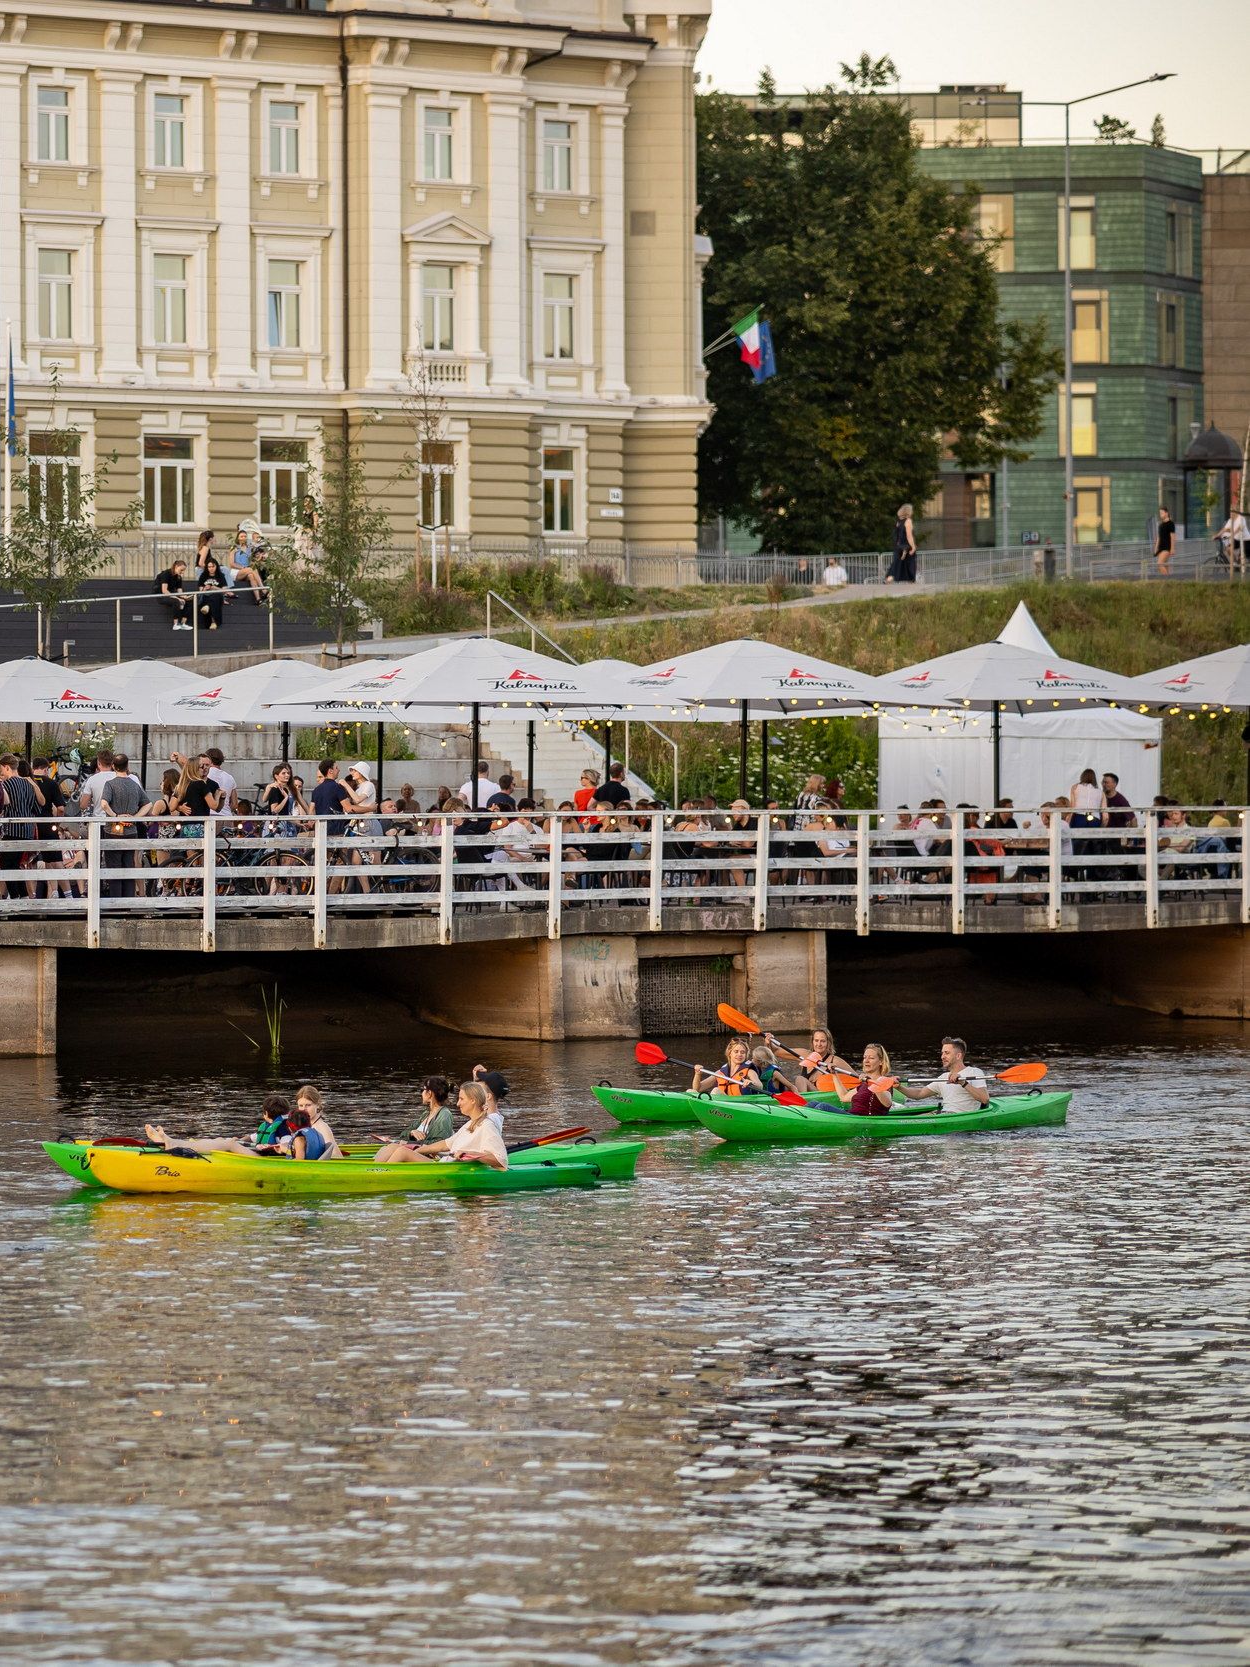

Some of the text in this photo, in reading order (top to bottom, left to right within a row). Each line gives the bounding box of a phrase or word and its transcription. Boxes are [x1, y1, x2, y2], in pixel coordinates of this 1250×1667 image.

[494, 680, 578, 691] Kalnapilis
[779, 678, 855, 689] Kalnapilis
[1036, 680, 1108, 689] Kalnapilis
[49, 700, 124, 711] Kalnapilis
[154, 1165, 181, 1177] Brio
